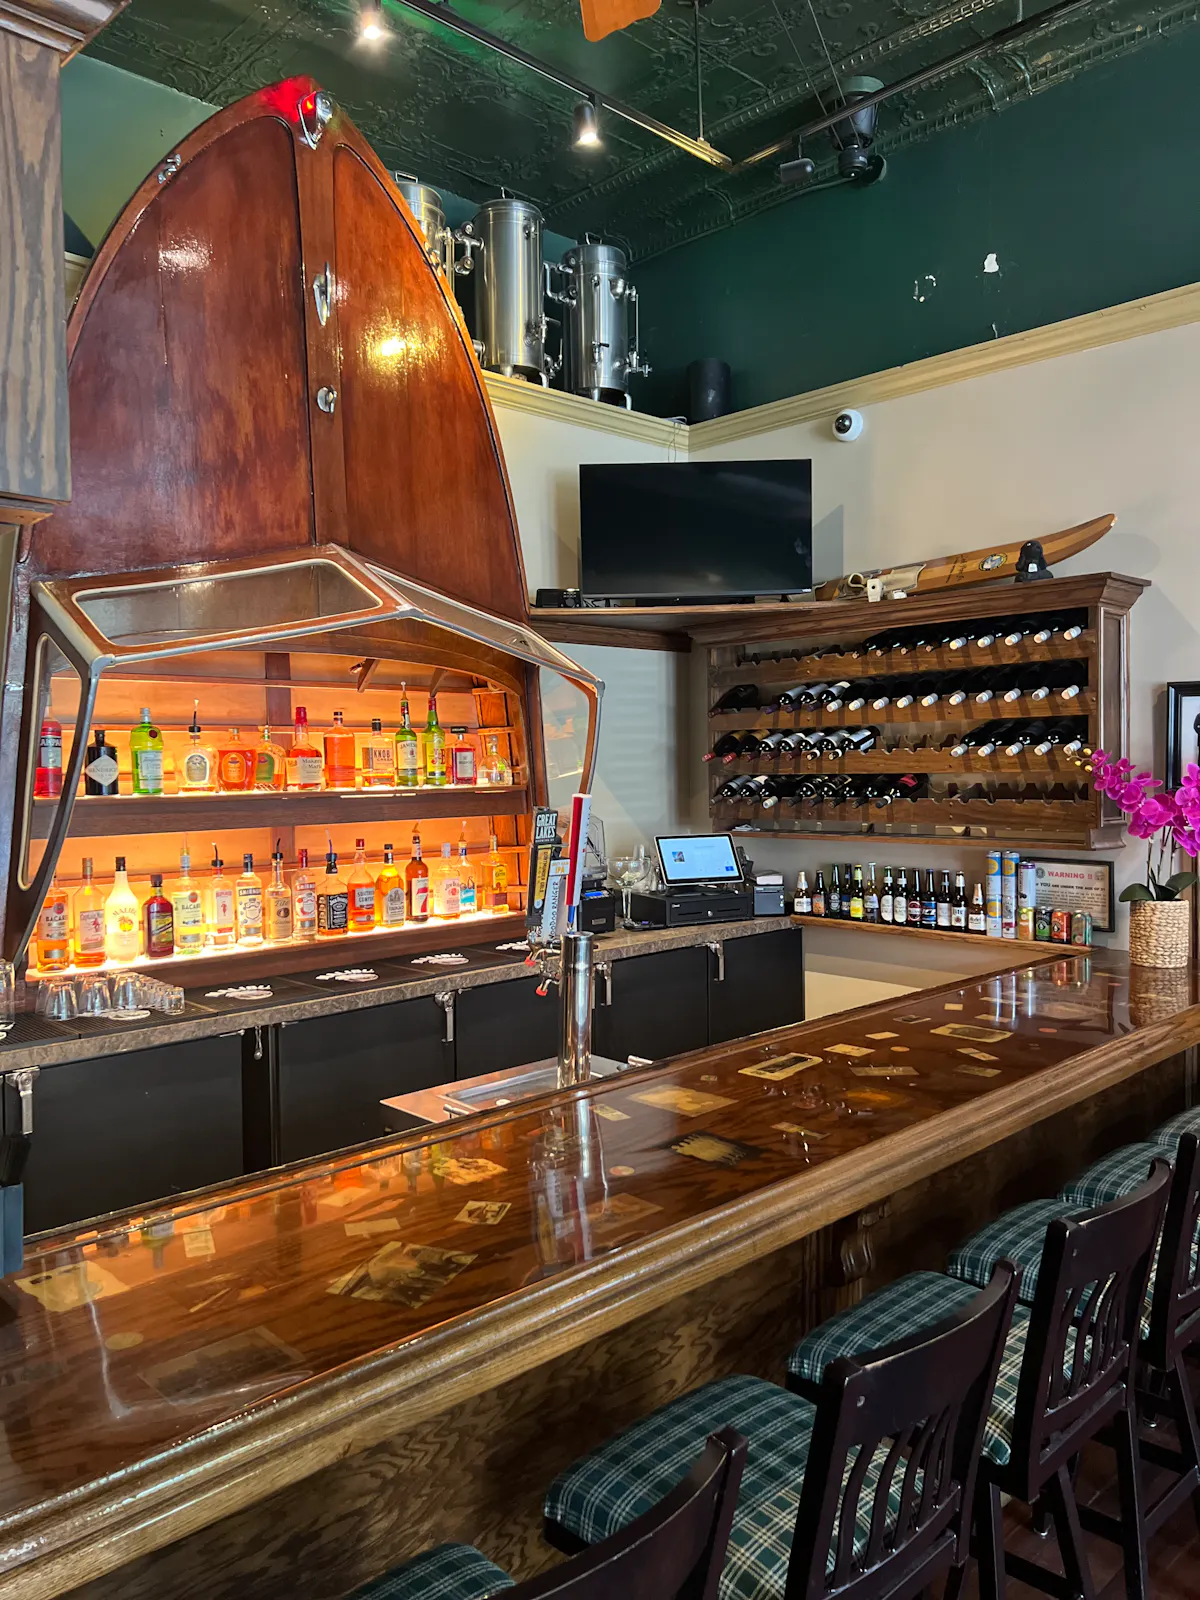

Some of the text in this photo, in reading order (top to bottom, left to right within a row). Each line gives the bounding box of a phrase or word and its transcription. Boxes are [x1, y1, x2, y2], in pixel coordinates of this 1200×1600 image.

[374, 749, 391, 758] KNOB
[537, 813, 558, 827] GREAT
[536, 826, 556, 840] LAKES
[556, 866, 565, 874] IPA
[1048, 871, 1085, 880] WARNING
[549, 910, 557, 940] VOODOO
